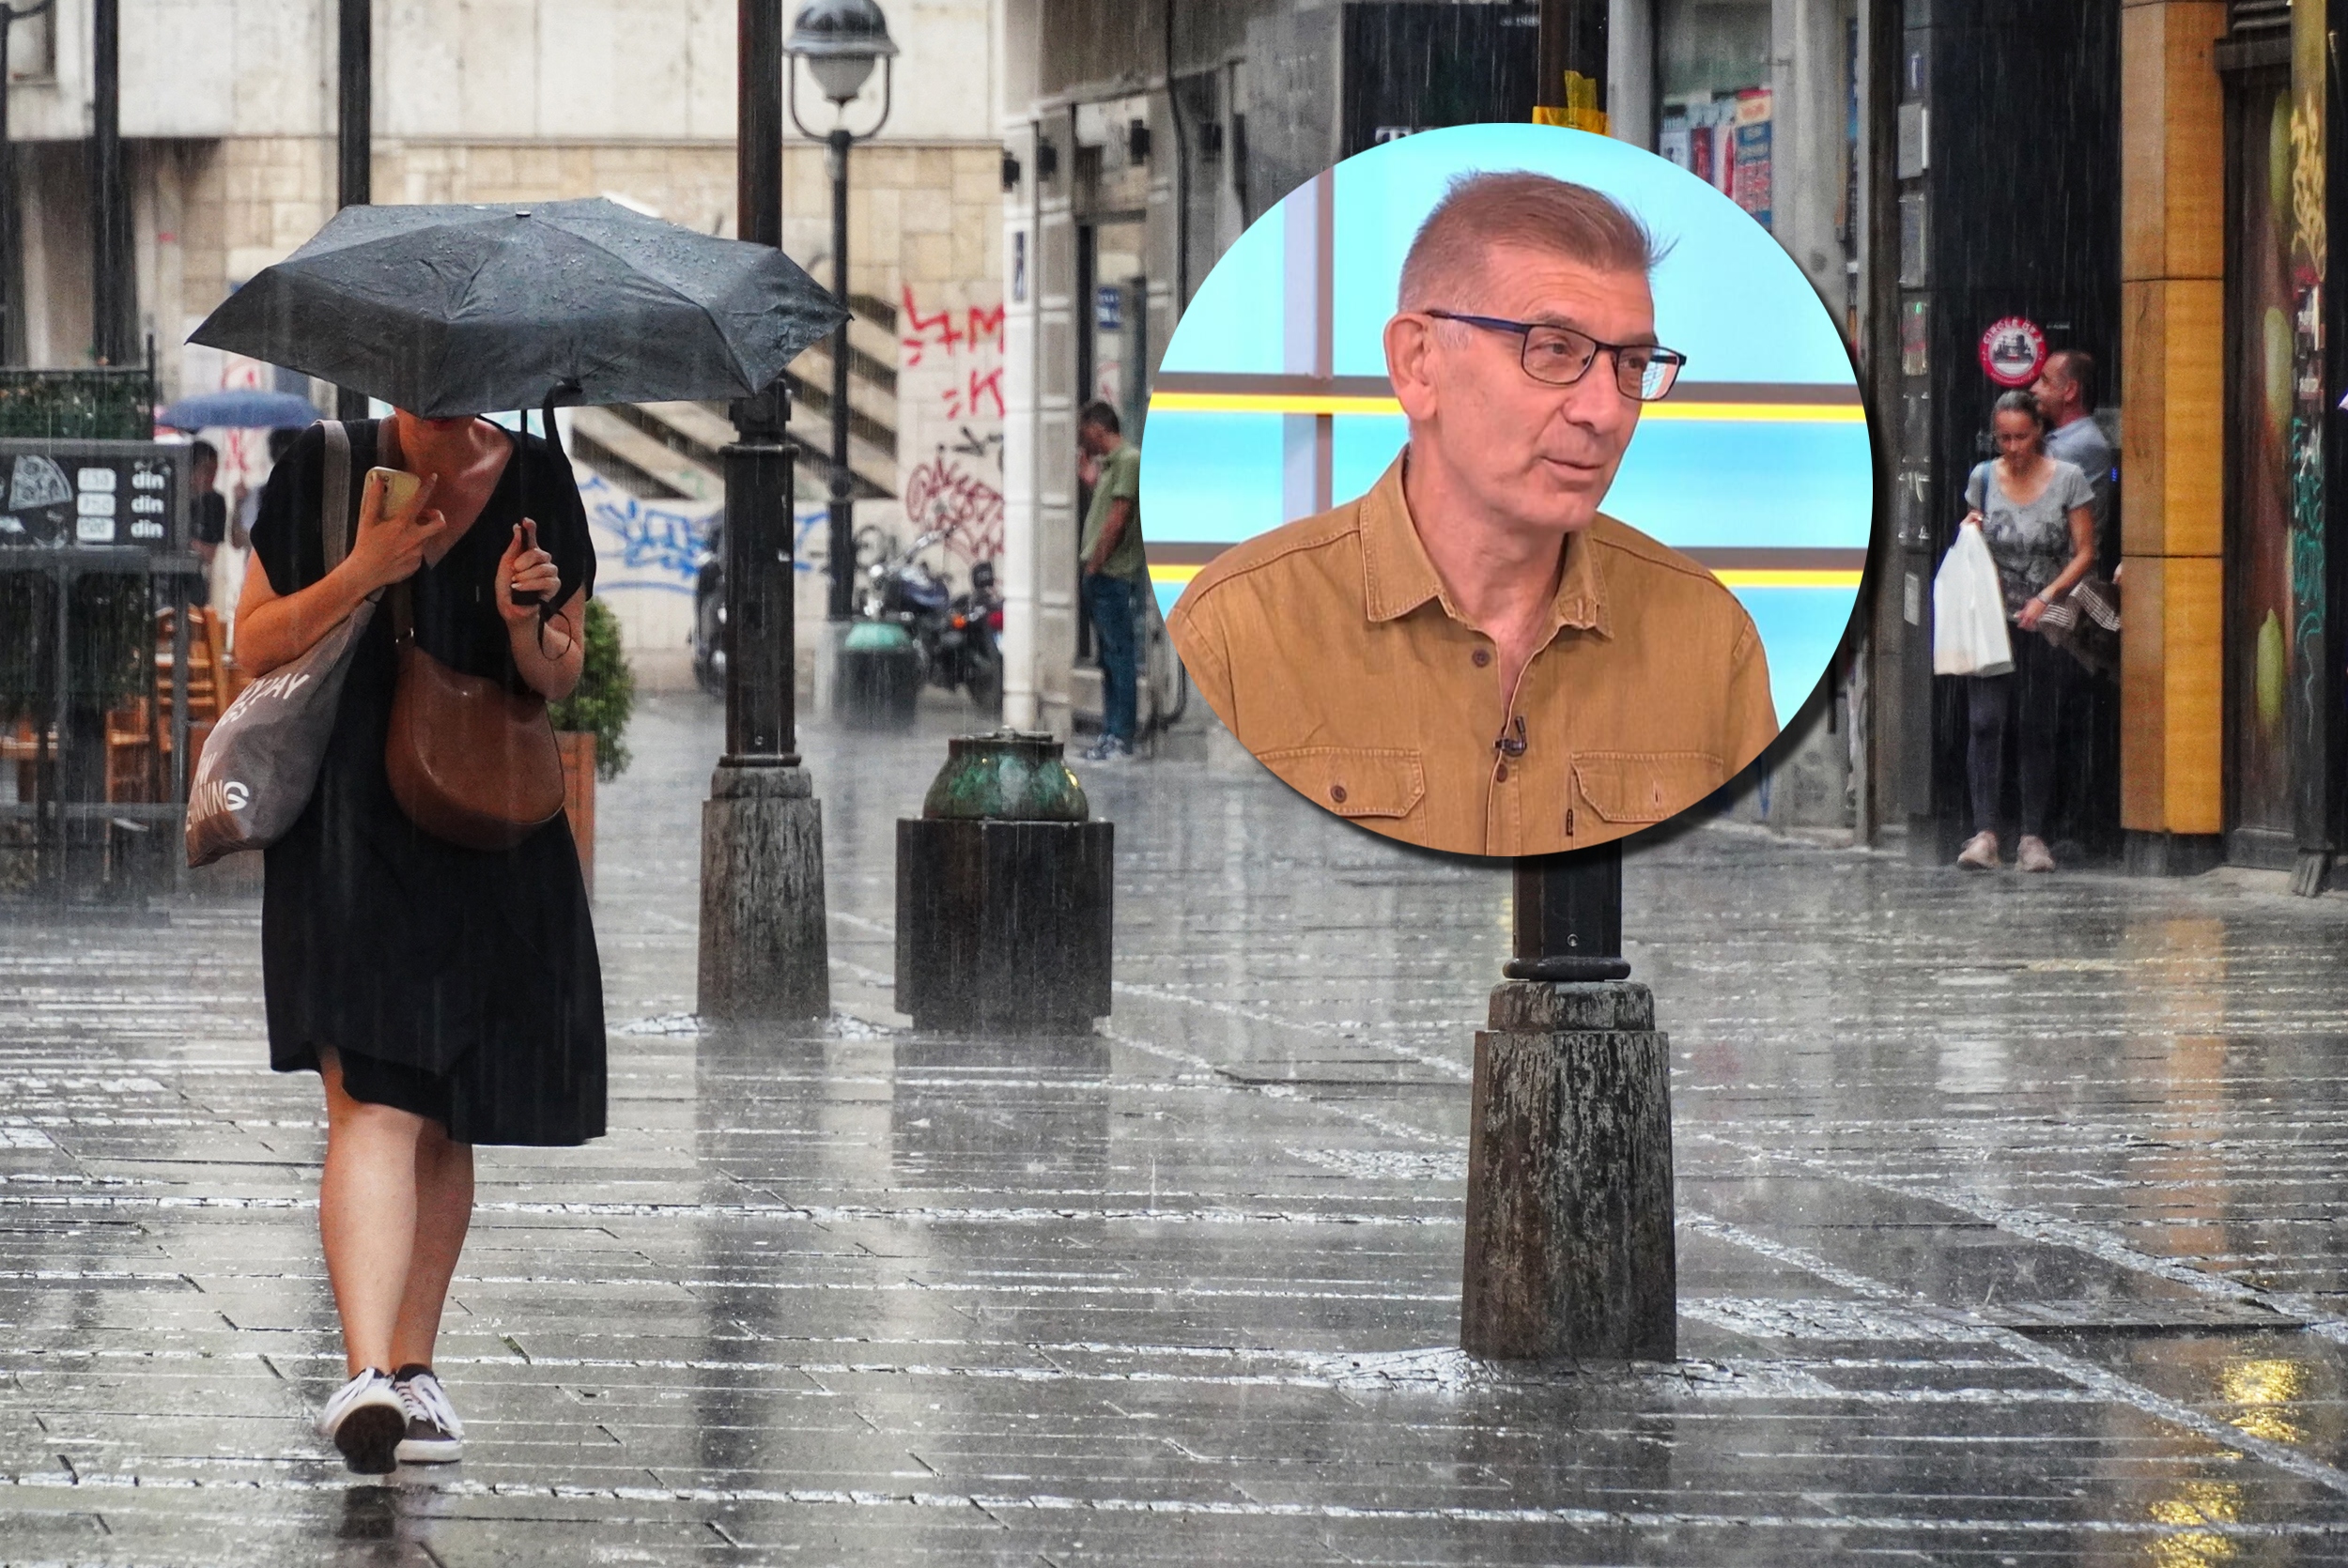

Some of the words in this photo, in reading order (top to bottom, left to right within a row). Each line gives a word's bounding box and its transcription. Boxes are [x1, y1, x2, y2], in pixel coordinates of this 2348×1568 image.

[1983, 316, 2019, 345] CIRCLE
[131, 495, 163, 514] din
[130, 519, 163, 538] din
